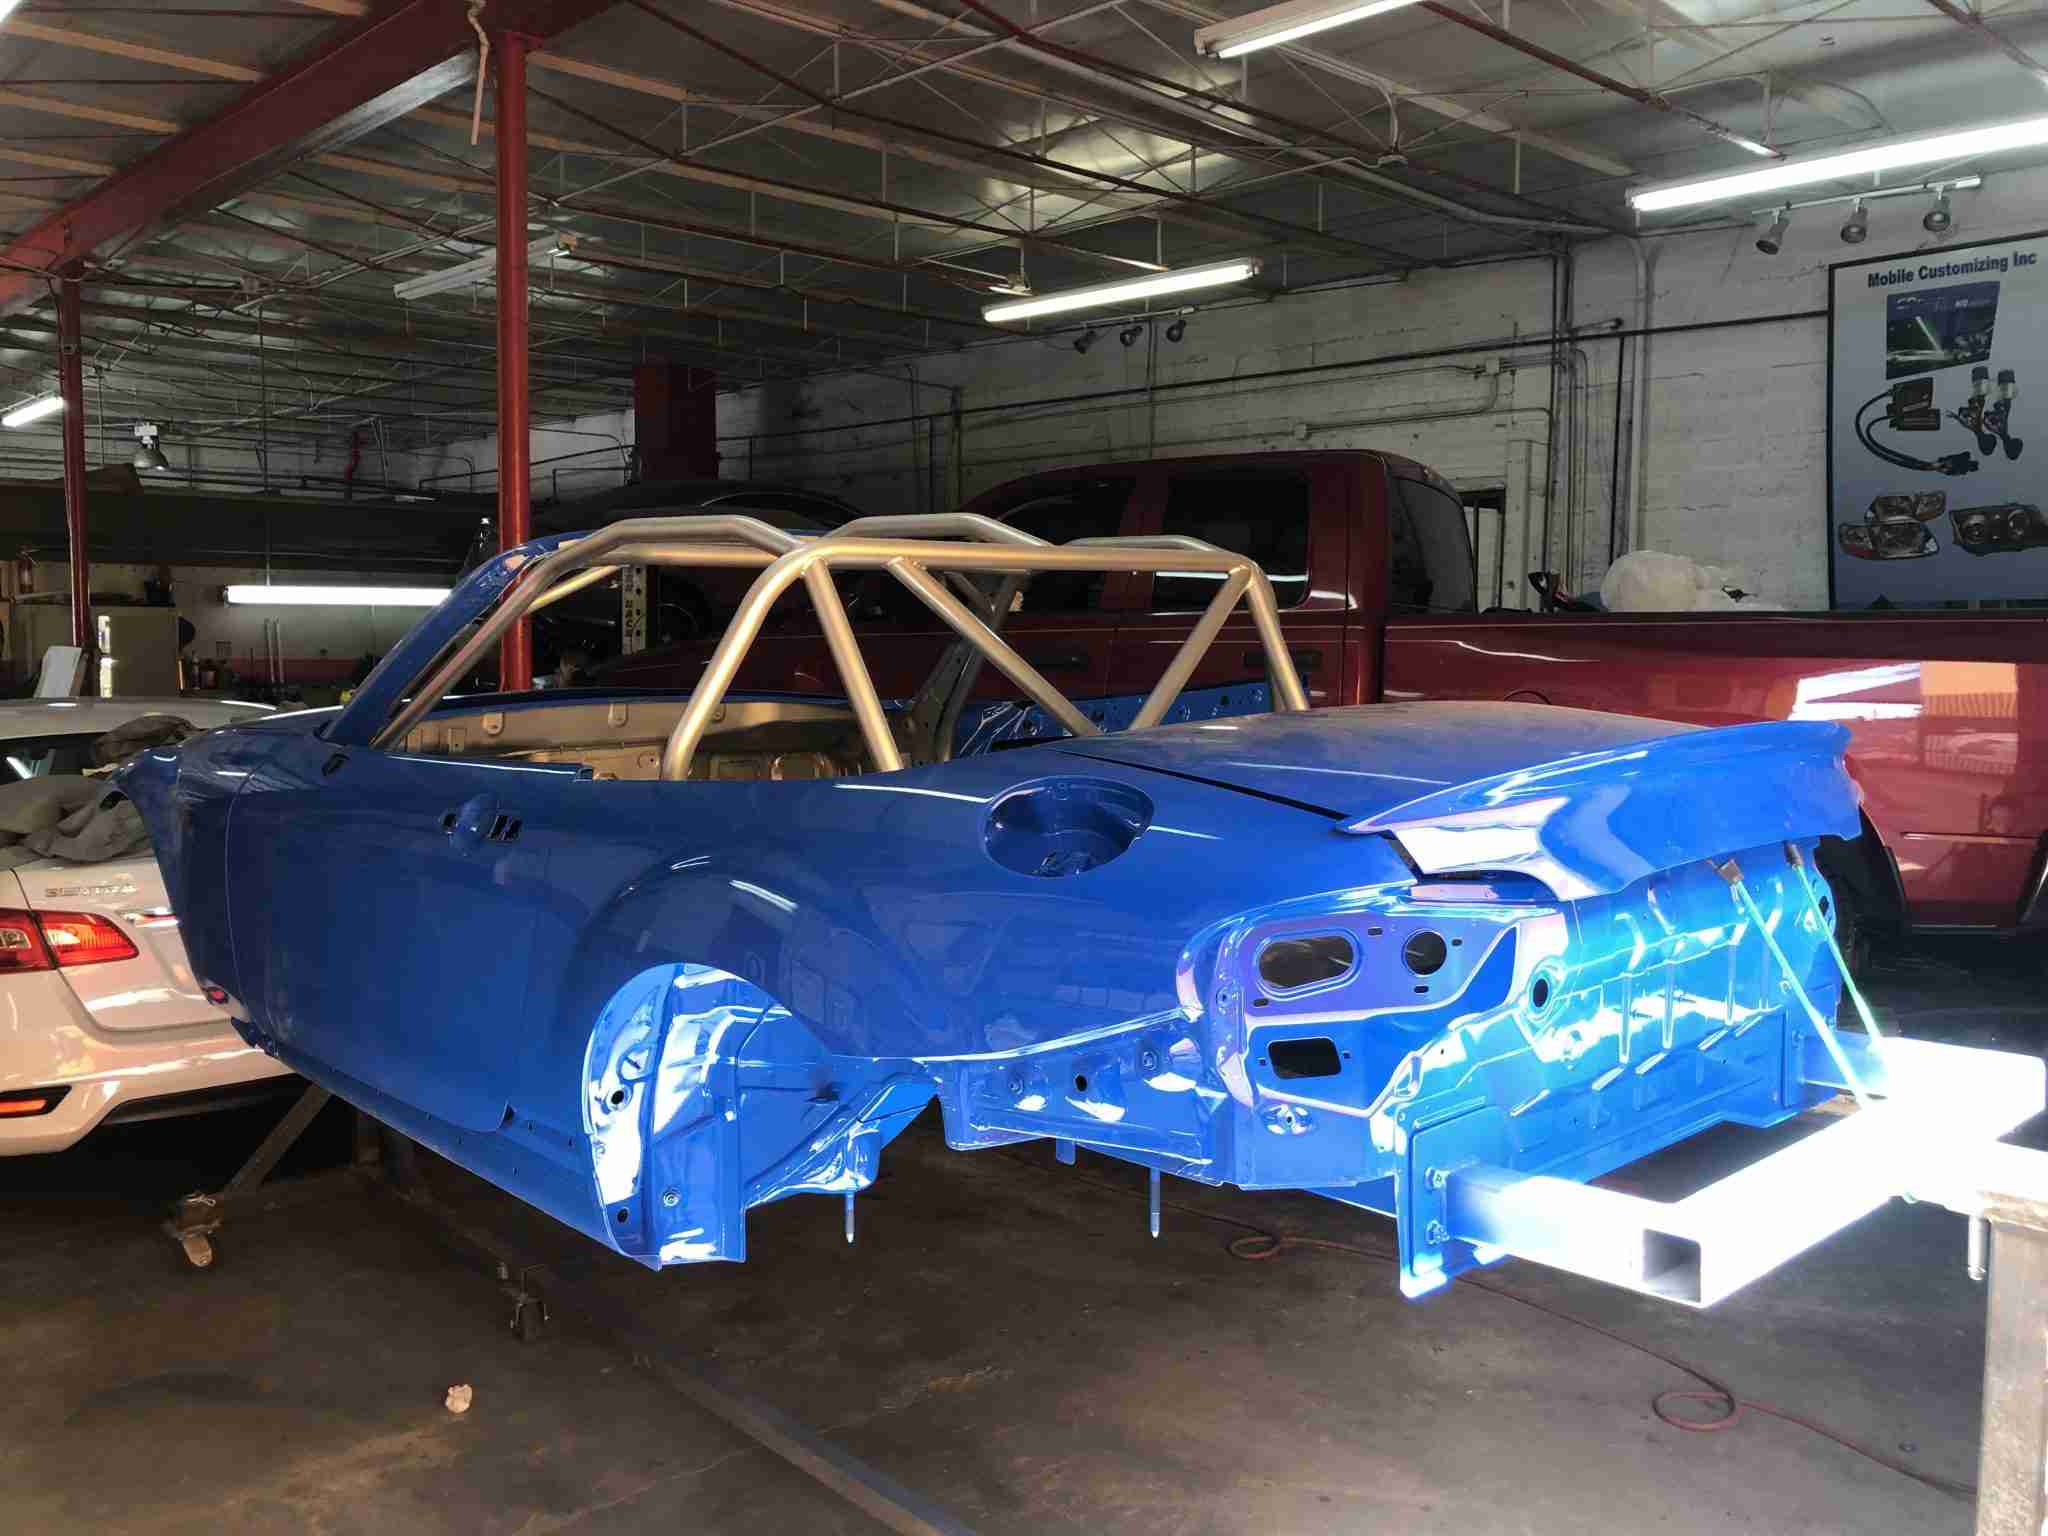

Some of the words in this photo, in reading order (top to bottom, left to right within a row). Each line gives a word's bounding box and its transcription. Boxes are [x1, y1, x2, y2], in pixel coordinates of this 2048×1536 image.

[1868, 268, 1914, 288] Mobile
[1918, 255, 2008, 281] Customizing
[2012, 250, 2037, 267] Inc
